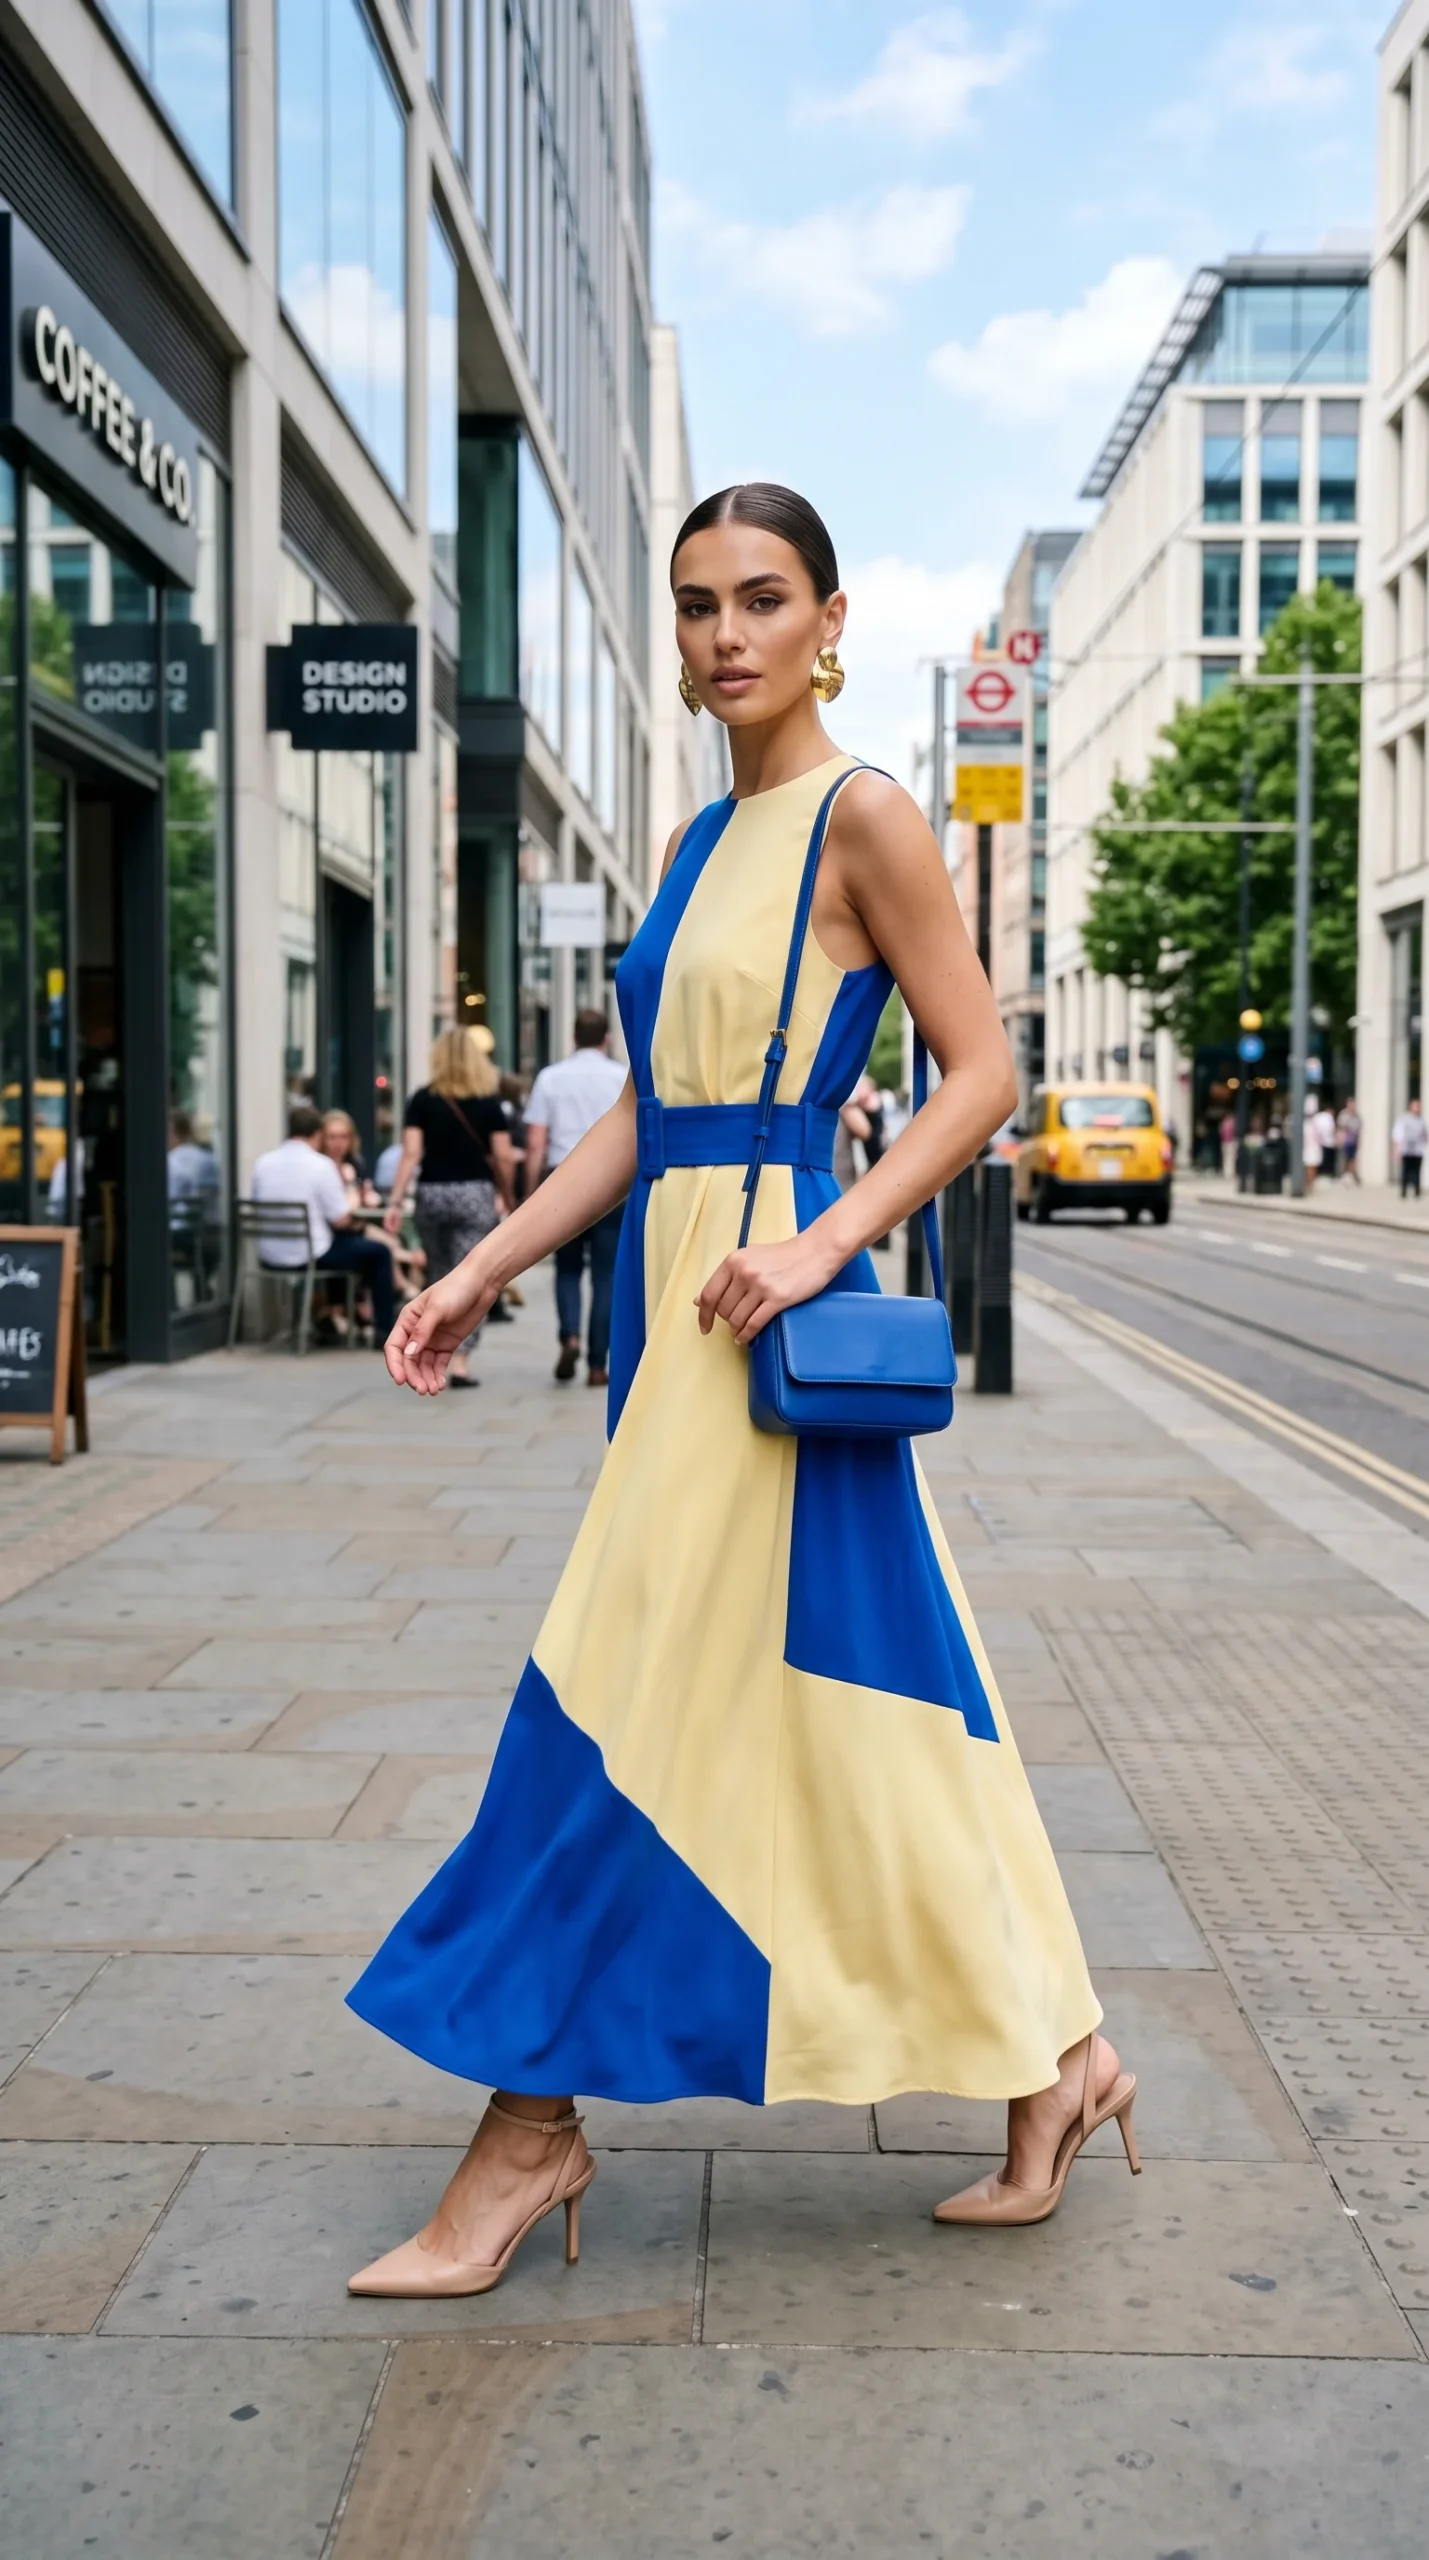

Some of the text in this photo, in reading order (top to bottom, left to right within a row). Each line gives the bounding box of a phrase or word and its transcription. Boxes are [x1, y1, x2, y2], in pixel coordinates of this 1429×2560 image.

[35, 305, 136, 467] COFFEE
[139, 417, 157, 489] &
[302, 660, 407, 687] DESIGN
[302, 687, 408, 714] STUDIO
